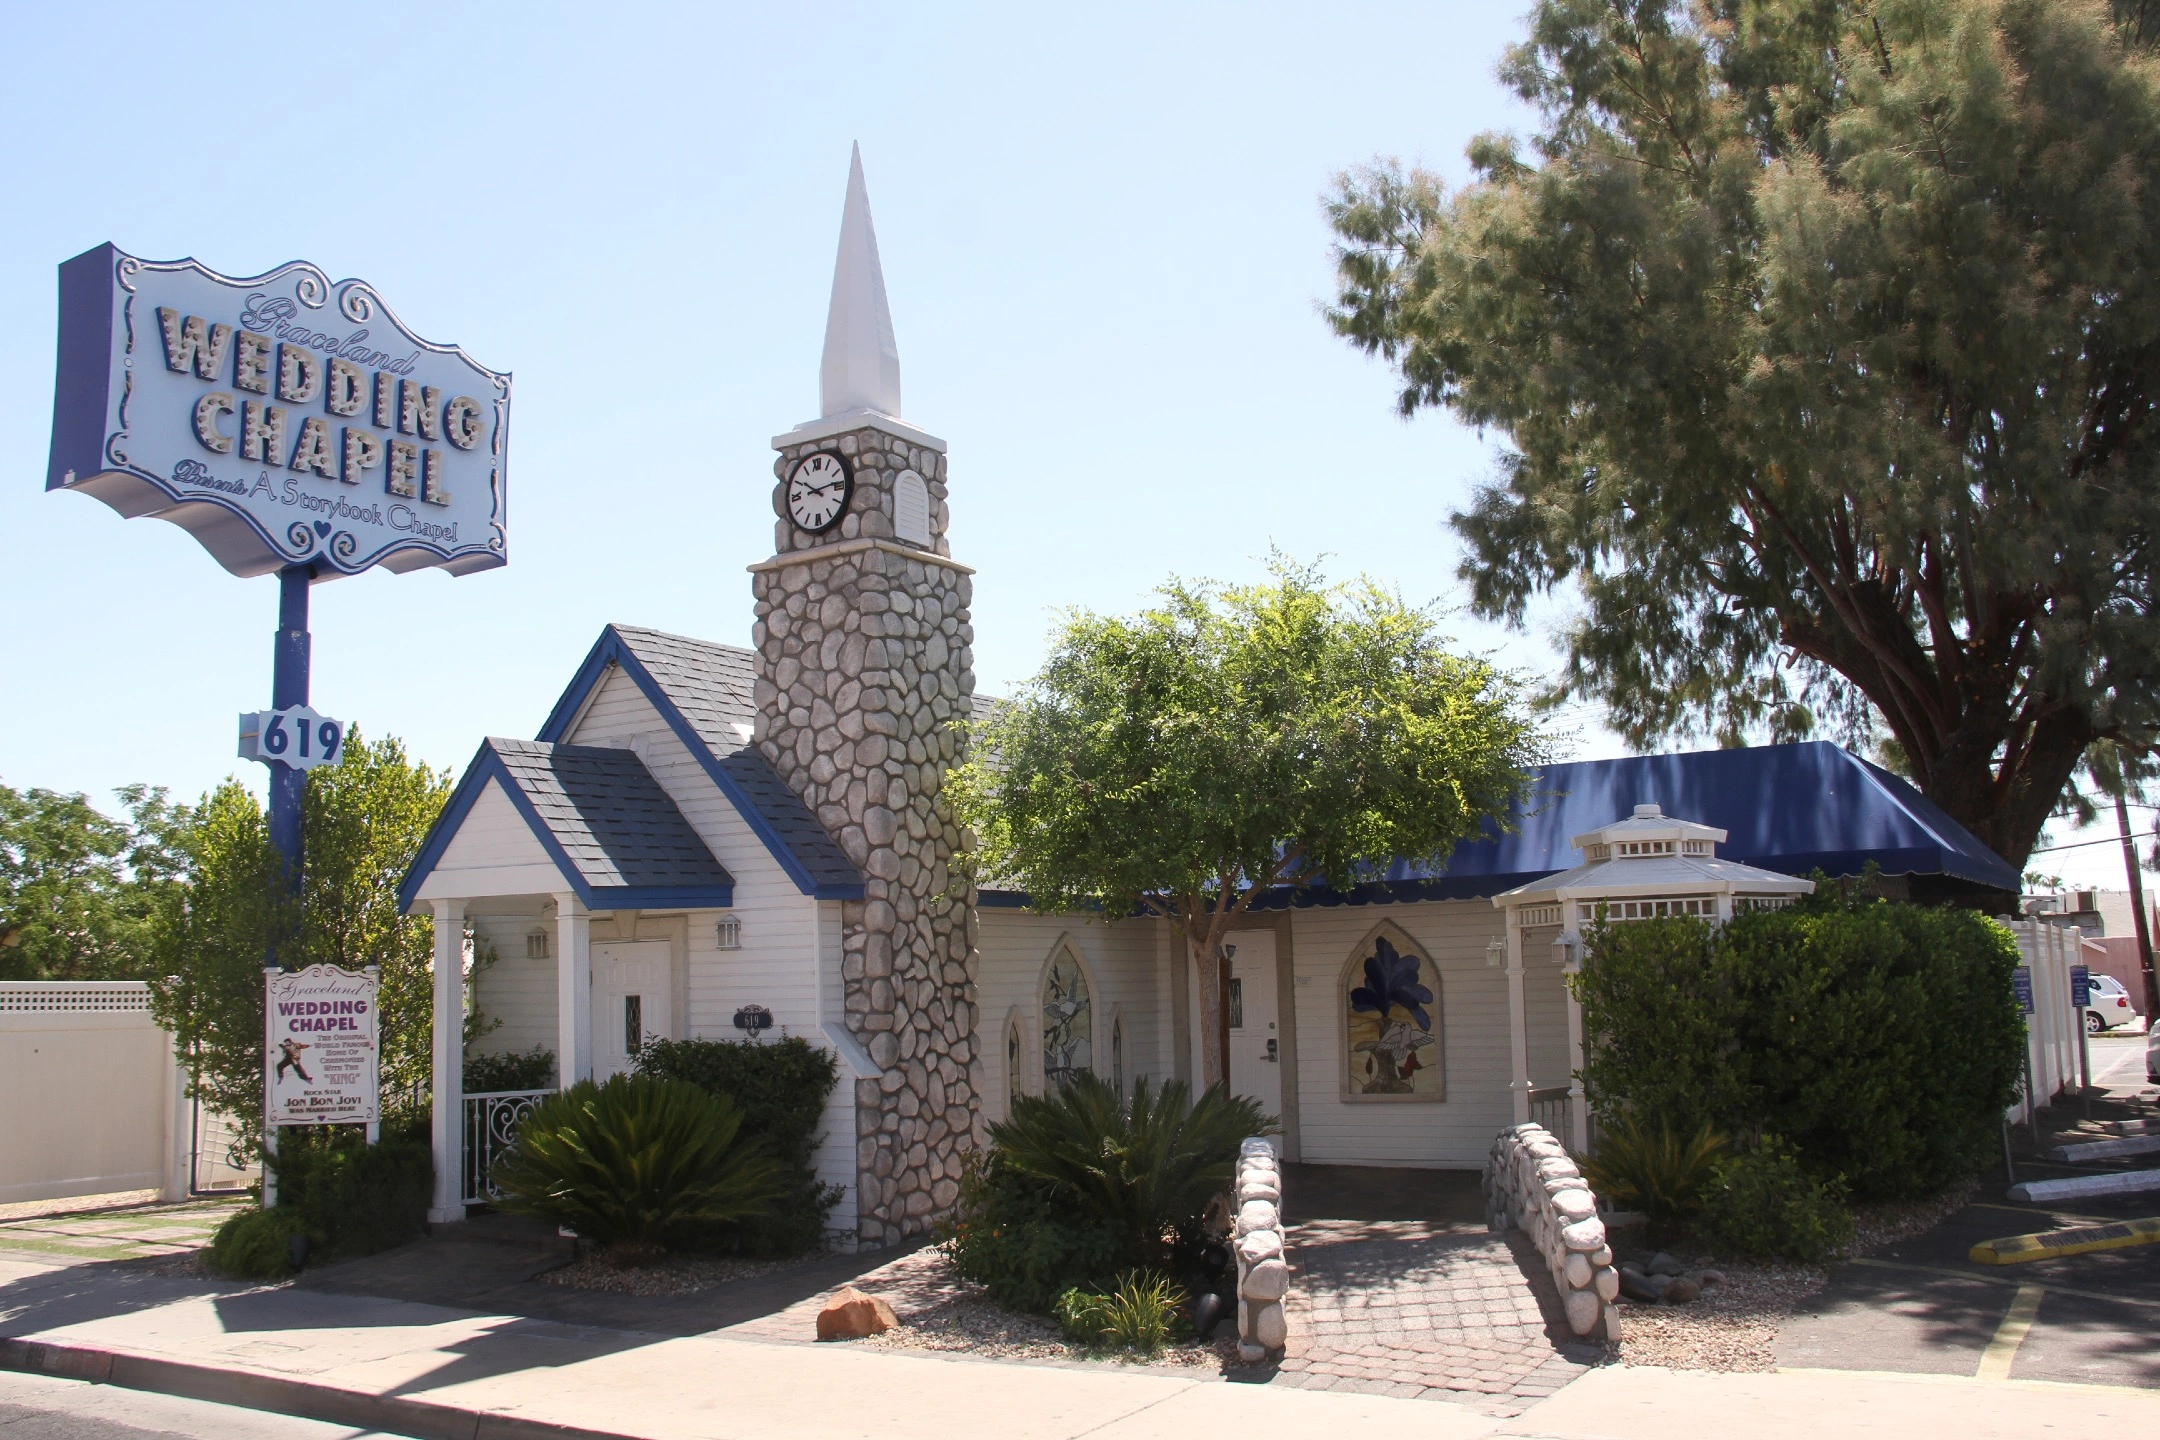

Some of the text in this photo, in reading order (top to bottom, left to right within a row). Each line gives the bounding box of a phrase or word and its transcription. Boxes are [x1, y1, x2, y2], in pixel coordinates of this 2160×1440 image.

[240, 293, 420, 376] Graceland
[155, 306, 486, 451] WEDDING
[190, 390, 452, 507] CHAPEL
[172, 459, 458, 542] Presents A Storybook Chapel
[264, 714, 340, 760] 619
[279, 980, 366, 1001] Graceland
[278, 1000, 368, 1016] WEDDING
[289, 1017, 358, 1032] CHAPEL
[744, 1015, 759, 1026] 619
[284, 1096, 362, 1107] JON BON JOVI
